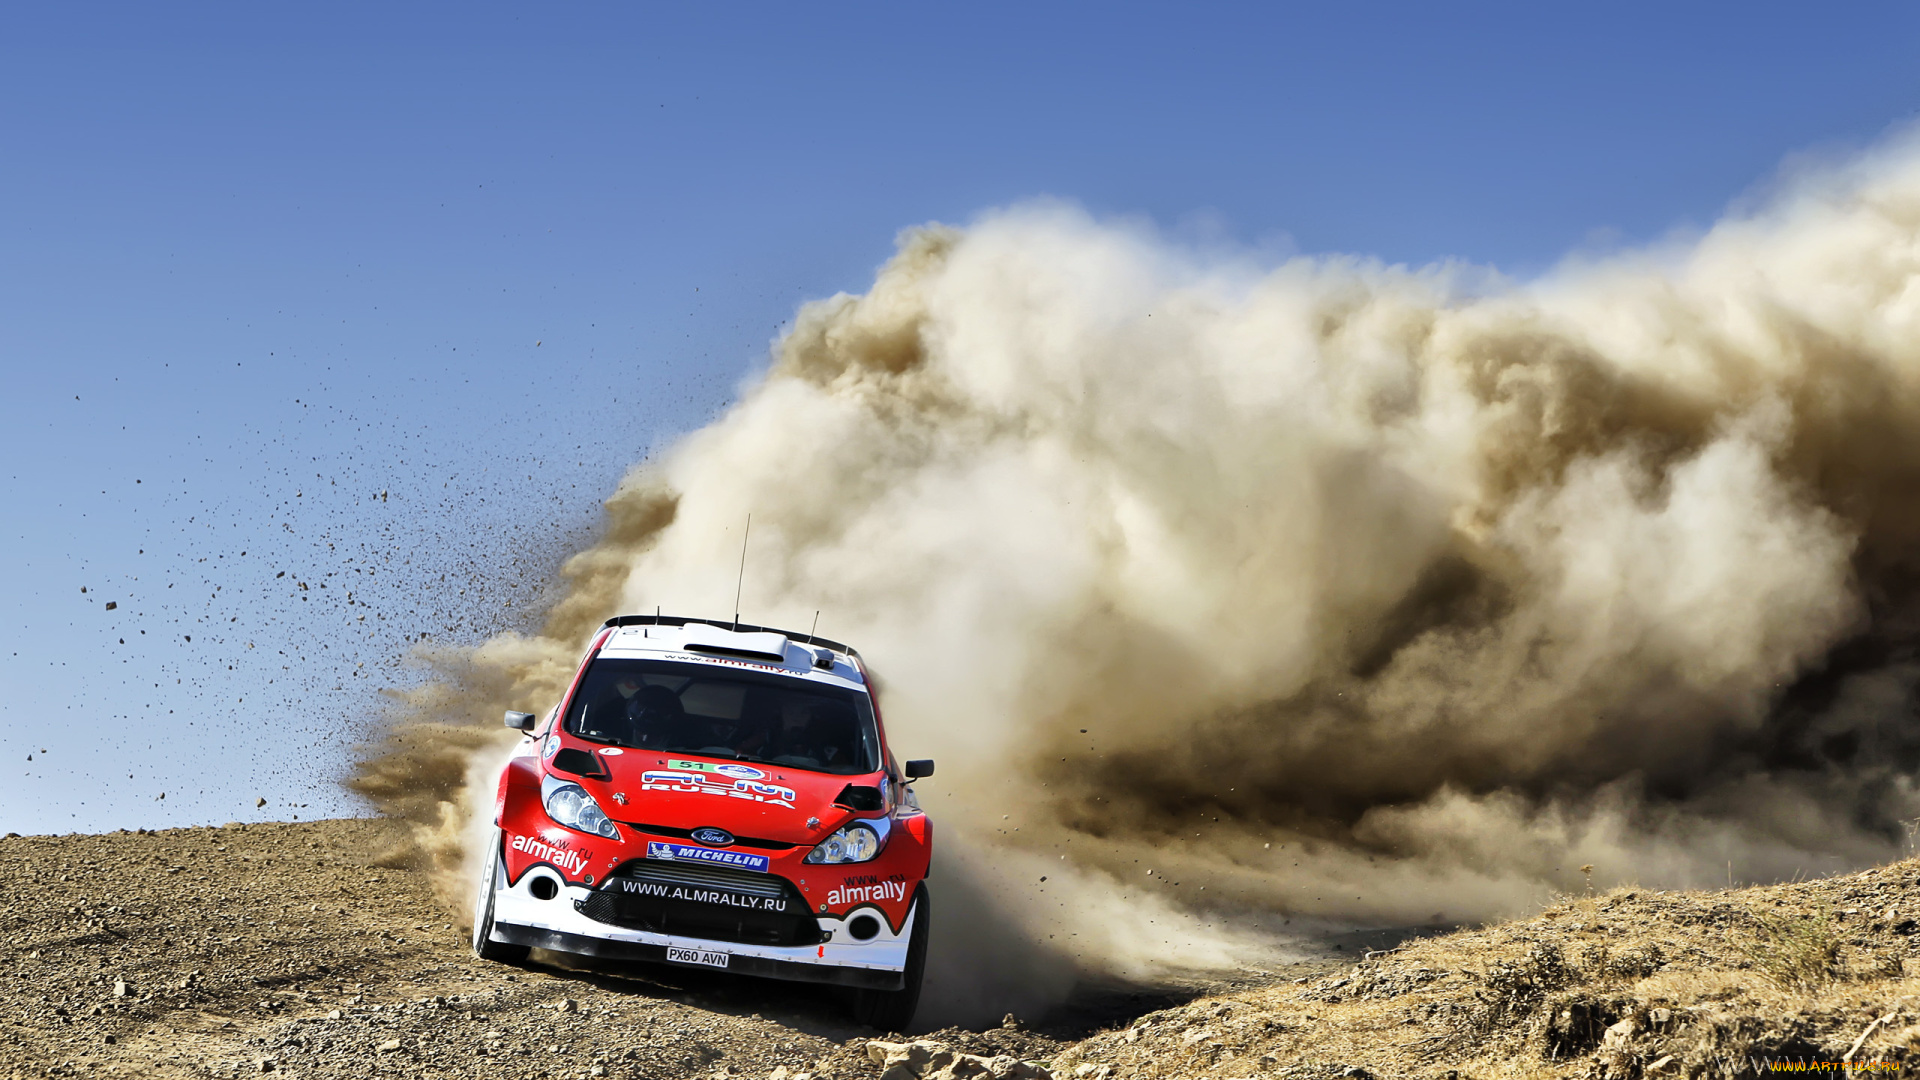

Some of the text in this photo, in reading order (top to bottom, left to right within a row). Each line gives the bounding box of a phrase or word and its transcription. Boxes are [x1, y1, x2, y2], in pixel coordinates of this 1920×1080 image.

[664, 654, 803, 676] www.almrally.ru
[679, 761, 704, 770] 51
[641, 783, 796, 810] RUSSIA
[700, 829, 725, 843] Ford
[511, 834, 589, 876] almrally
[677, 847, 763, 867] MICHELIN
[622, 880, 786, 912] WWW.ALMRALLY.RU
[827, 880, 907, 906] almrally
[668, 948, 727, 966] PX60 AVN
